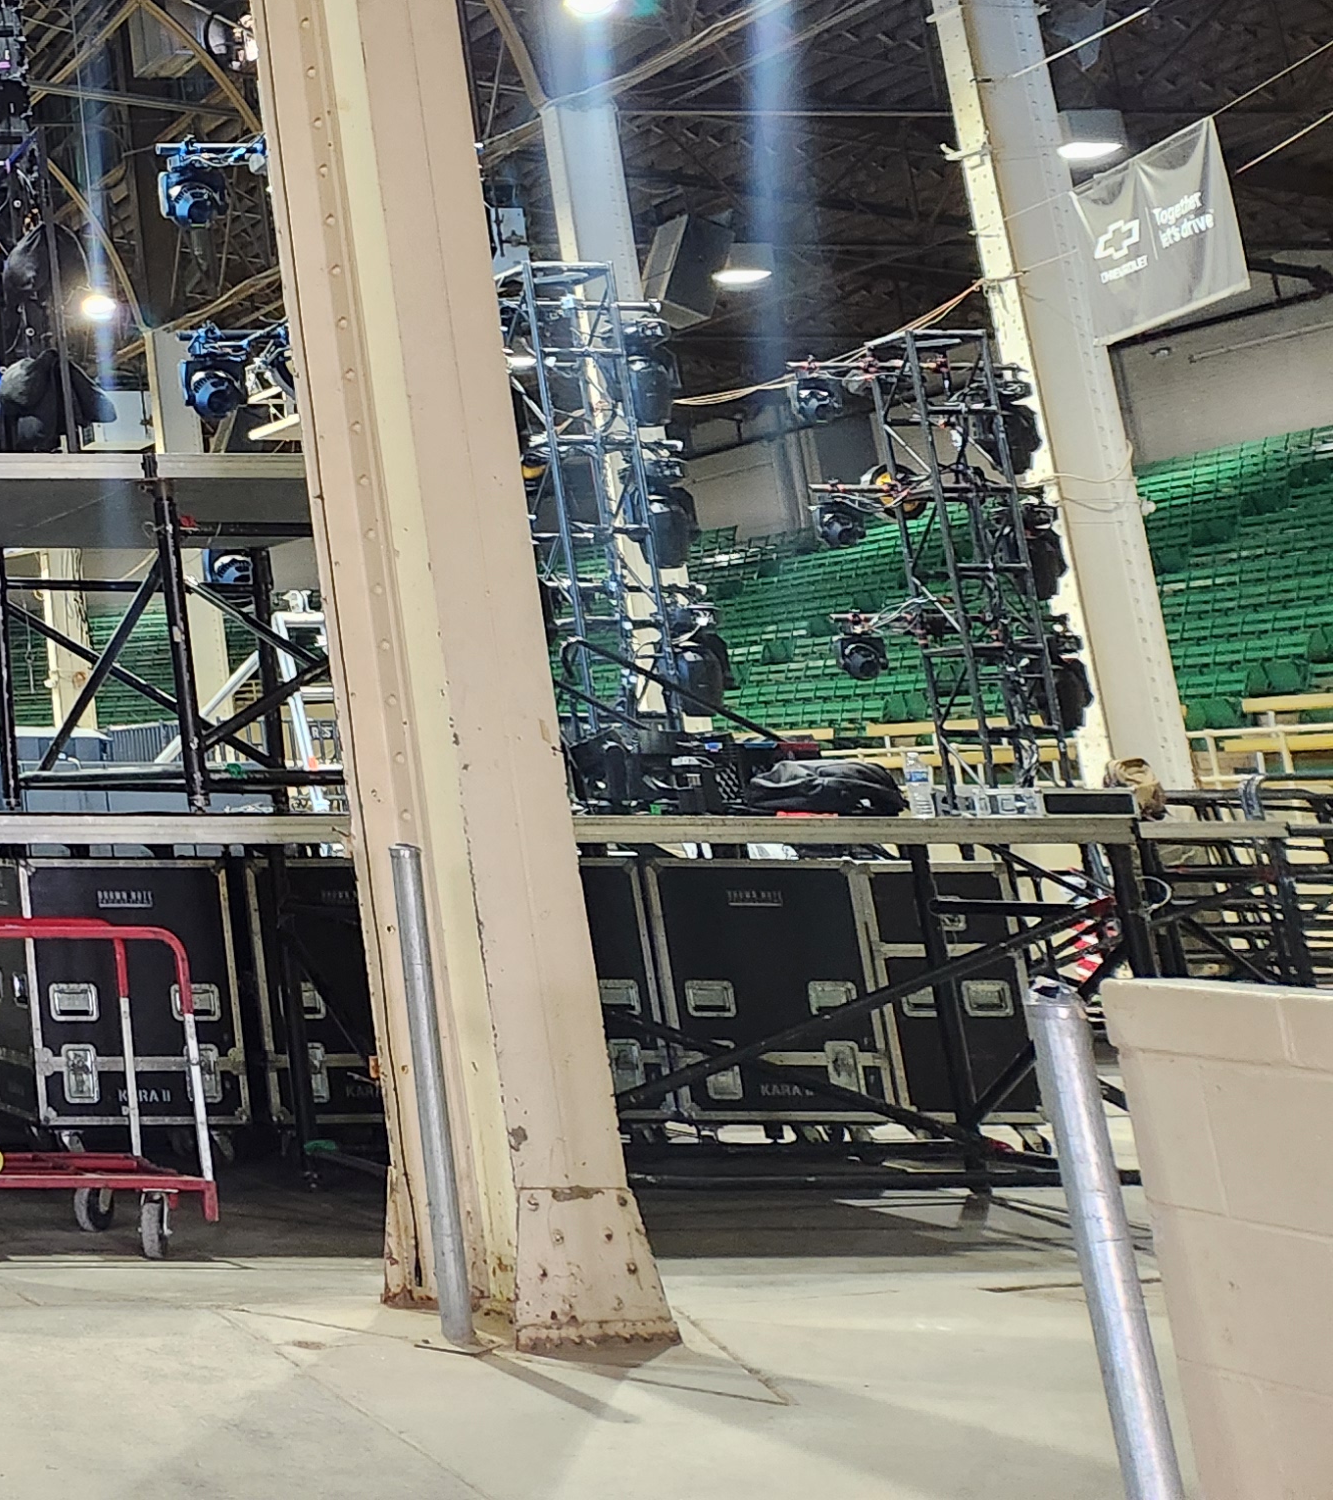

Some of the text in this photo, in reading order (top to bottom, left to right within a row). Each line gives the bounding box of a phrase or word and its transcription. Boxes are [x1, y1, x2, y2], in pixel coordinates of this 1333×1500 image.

[1152, 191, 1203, 226] Together
[1179, 212, 1215, 240] drive
[118, 1089, 160, 1102] KRA
[759, 1084, 803, 1096] KARA
